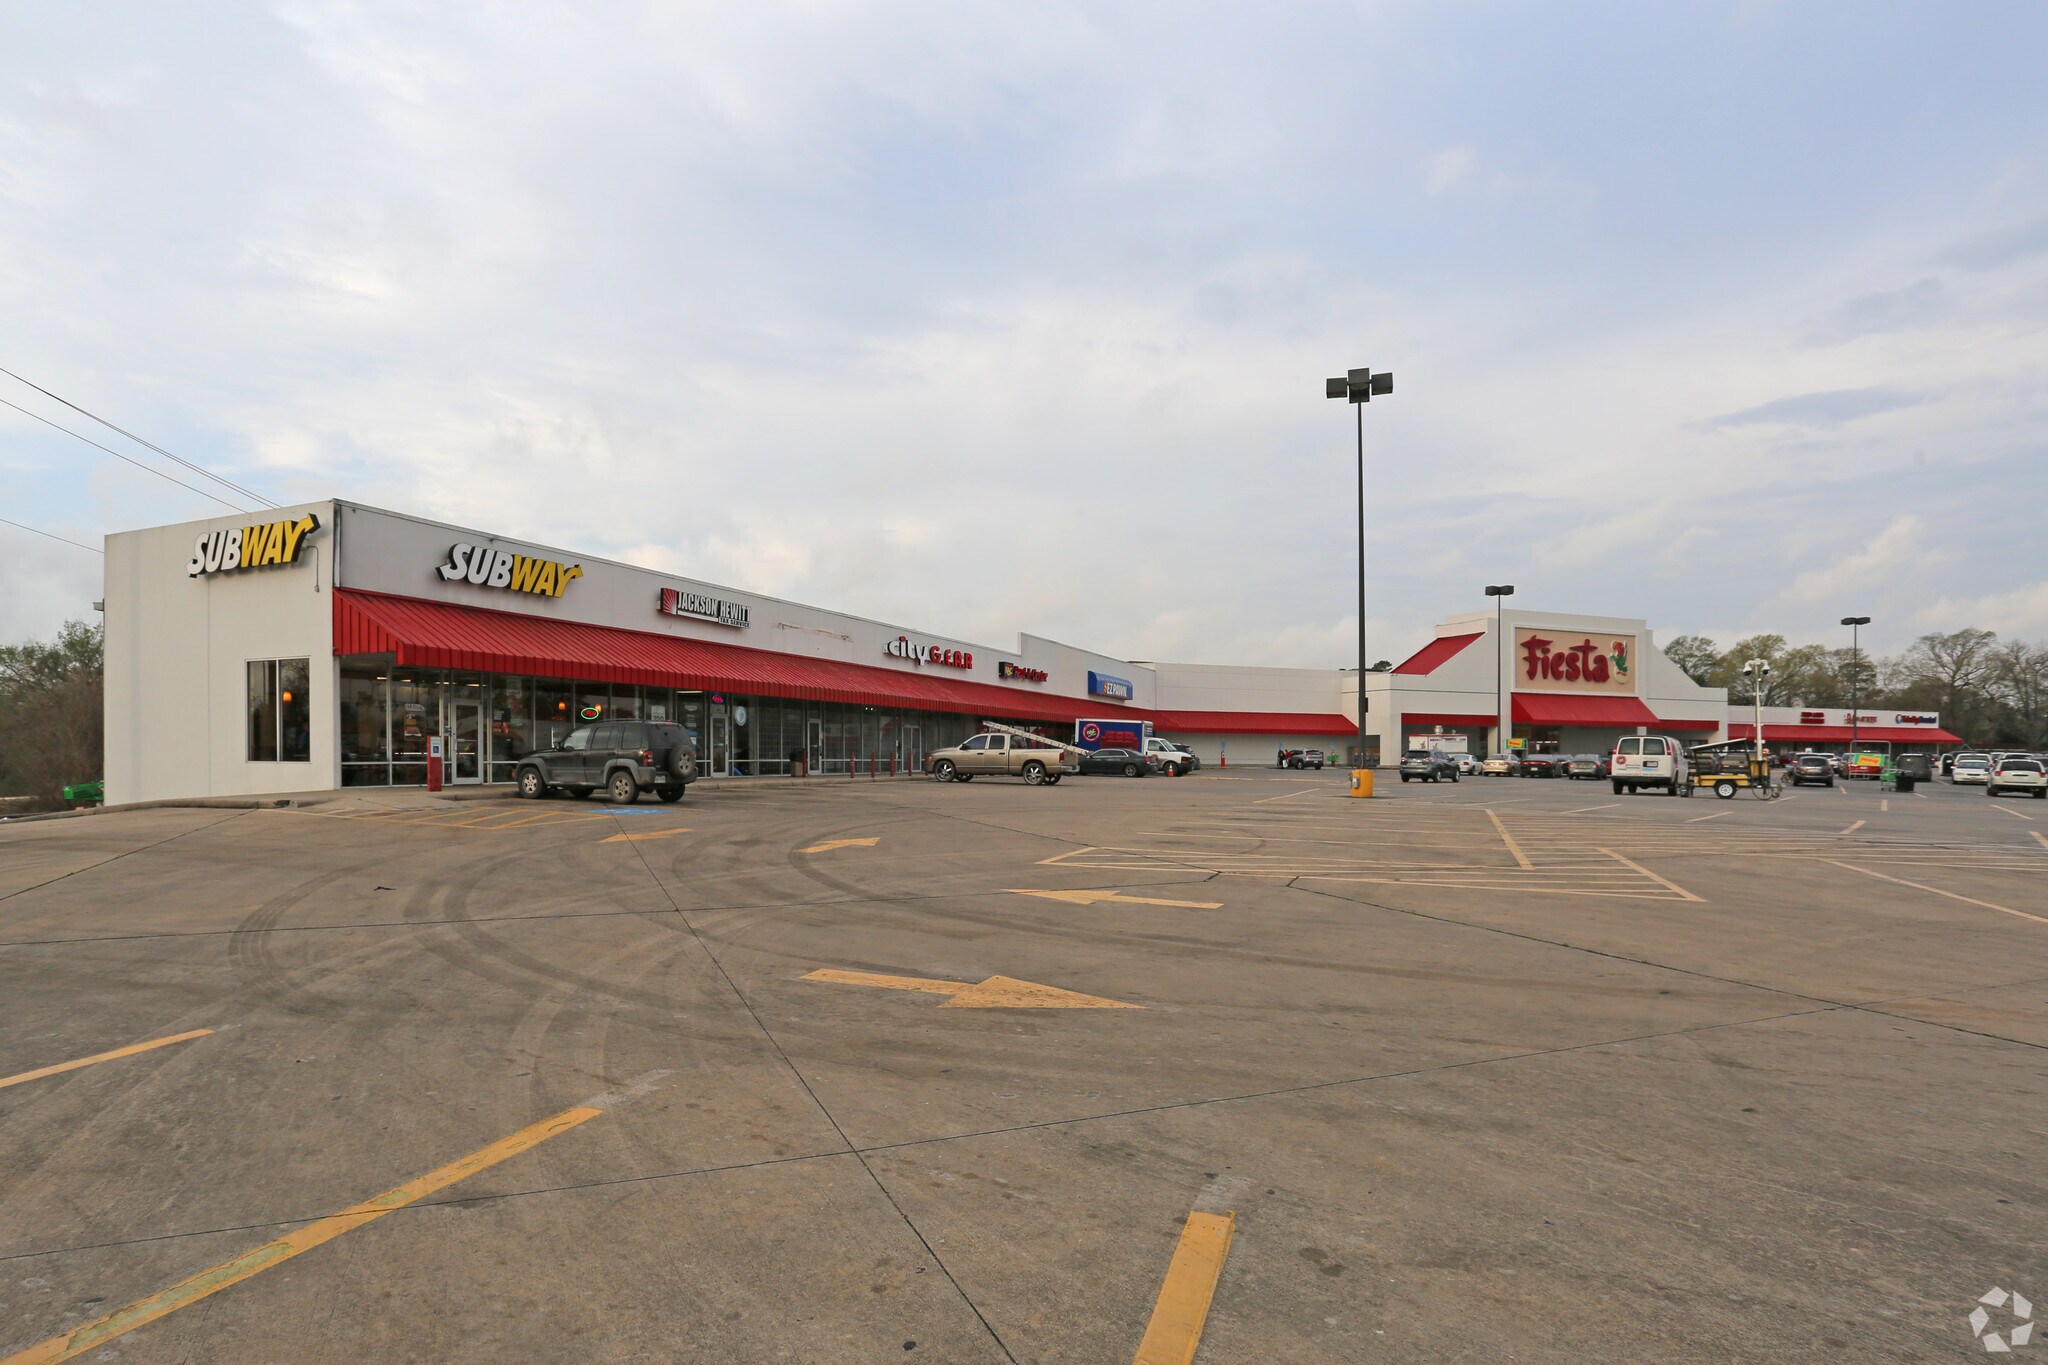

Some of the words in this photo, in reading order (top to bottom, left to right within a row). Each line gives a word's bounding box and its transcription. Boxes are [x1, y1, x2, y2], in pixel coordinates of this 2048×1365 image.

[186, 513, 320, 578] SUBWAY
[436, 543, 584, 599] SUBWAY
[677, 591, 718, 618] JACKSON
[720, 600, 751, 622] HEWITT
[730, 619, 750, 629] SERVICE
[1520, 634, 1610, 682] Fiesta
